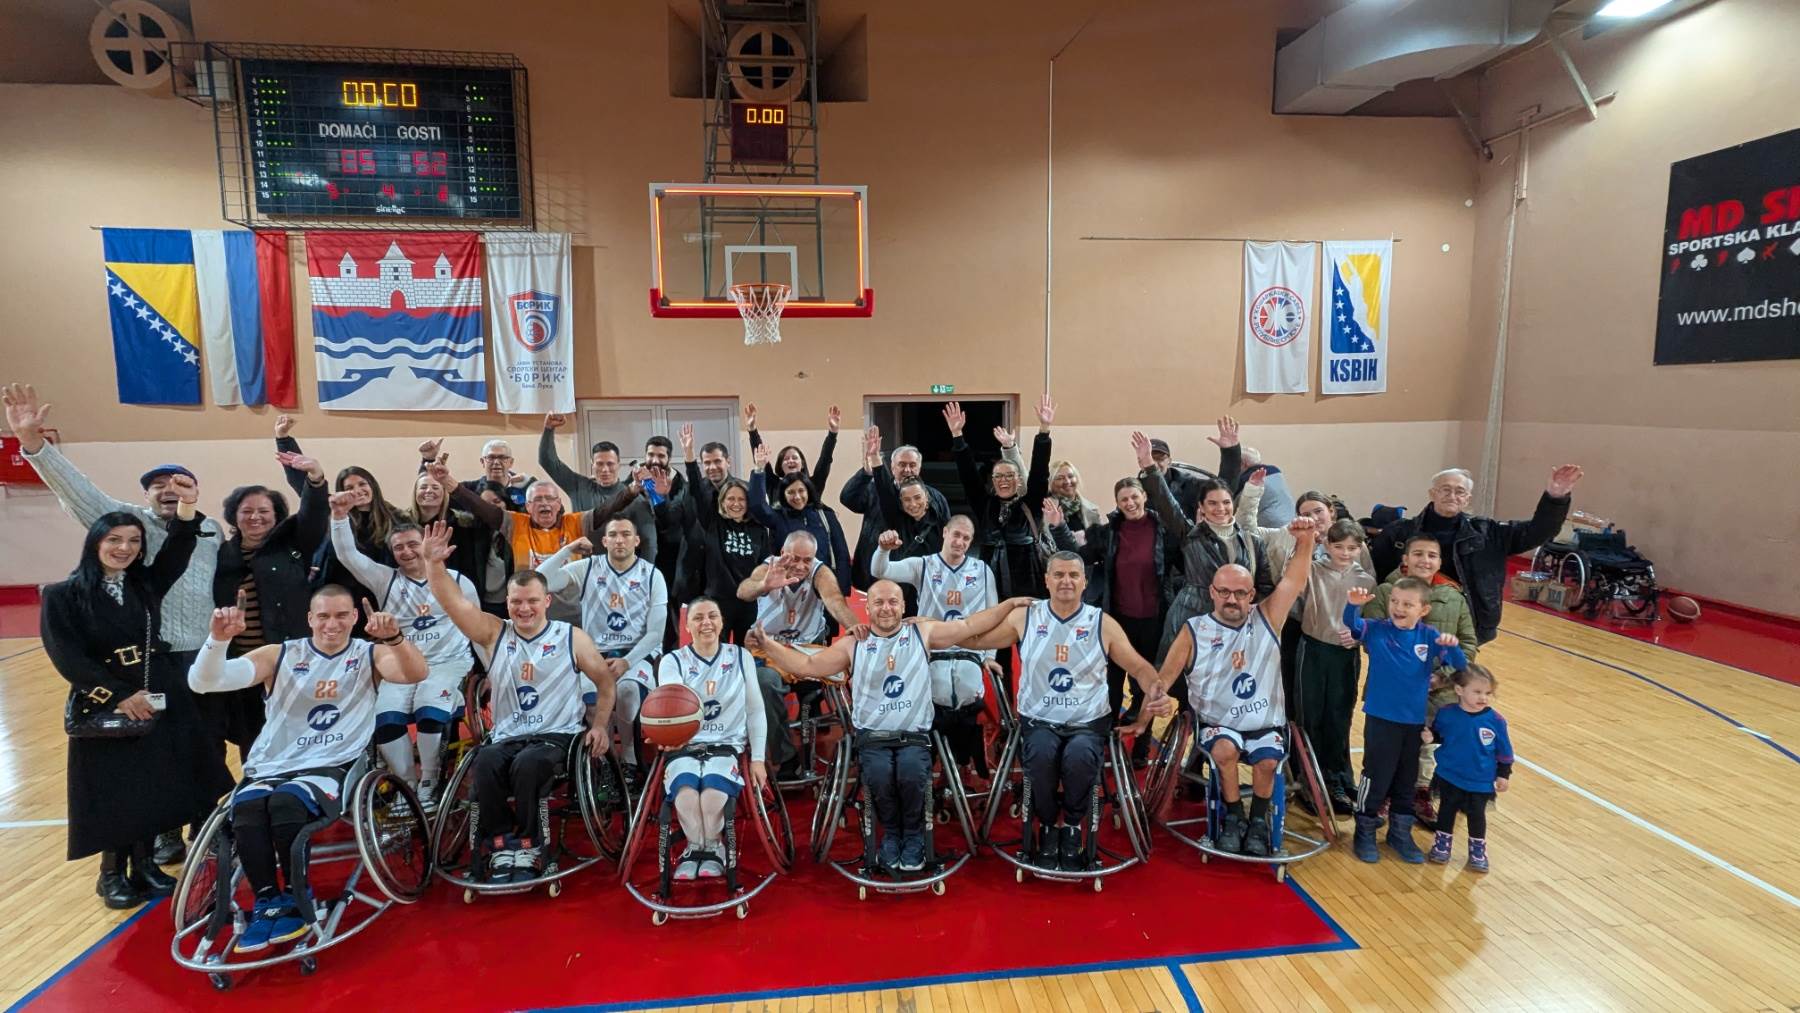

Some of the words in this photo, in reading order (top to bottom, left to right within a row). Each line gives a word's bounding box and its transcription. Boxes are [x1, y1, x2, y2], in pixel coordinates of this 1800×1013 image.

[746, 108, 784, 124] 0.00
[397, 125, 441, 141] GOSTI
[256, 140, 264, 148] 10
[259, 171, 267, 179] 13
[260, 181, 269, 189] 14
[261, 191, 270, 199] 15
[1677, 199, 1744, 240] MD
[1668, 229, 1761, 256] SPORTSKA
[516, 301, 551, 310] БОРИК
[1330, 358, 1378, 382] KSBIH
[1055, 644, 1070, 662] 15
[315, 680, 338, 698] 22
[878, 700, 912, 715] grupa
[1042, 696, 1079, 708] grupa
[1230, 698, 1269, 719] grupa
[296, 732, 344, 750] grupa
